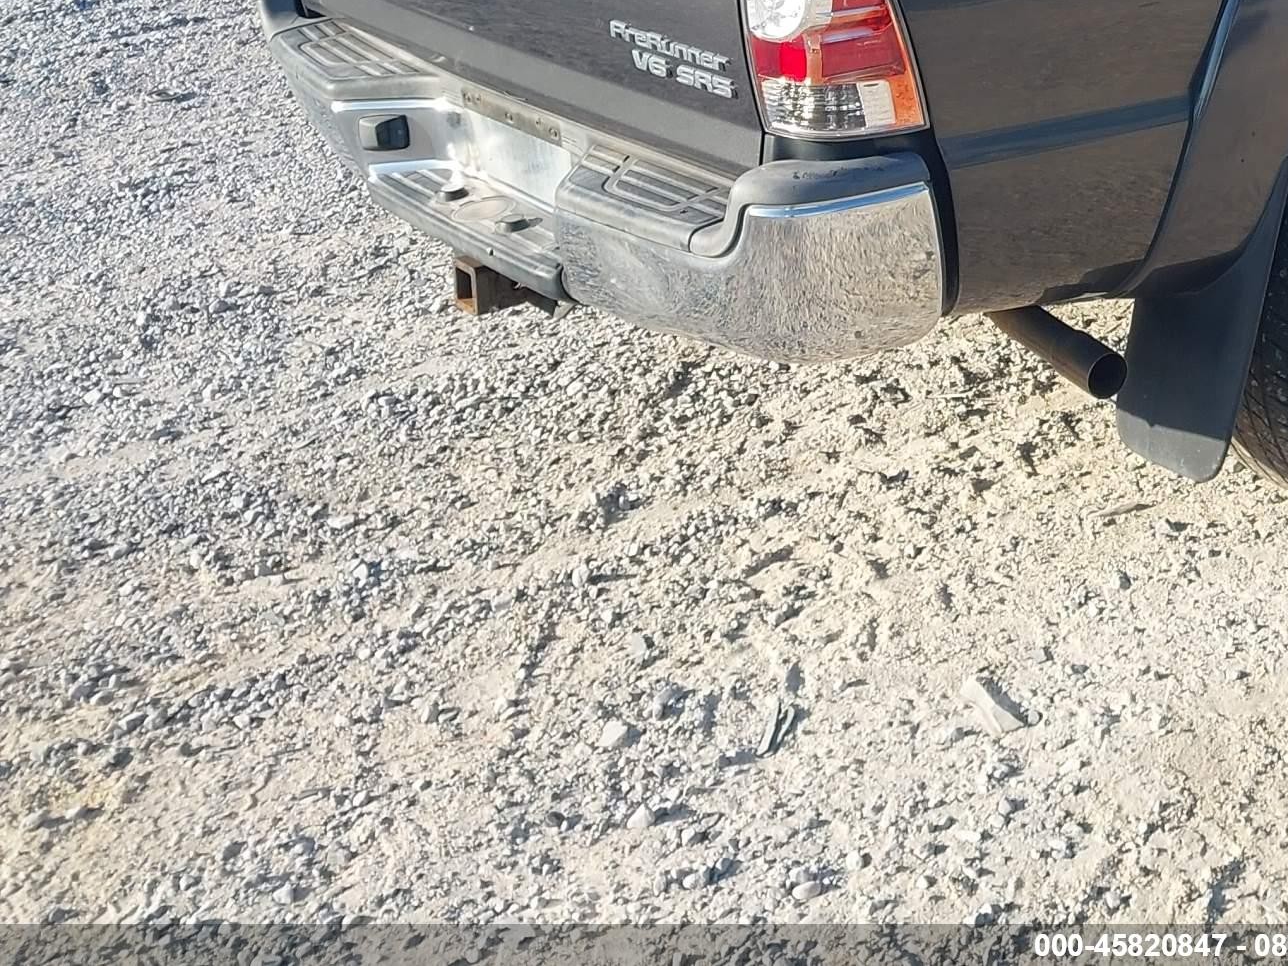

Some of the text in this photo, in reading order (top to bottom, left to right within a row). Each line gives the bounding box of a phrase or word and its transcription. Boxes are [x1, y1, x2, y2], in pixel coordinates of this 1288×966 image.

[609, 19, 732, 71] PreRunner
[631, 49, 736, 99] V6 SR5
